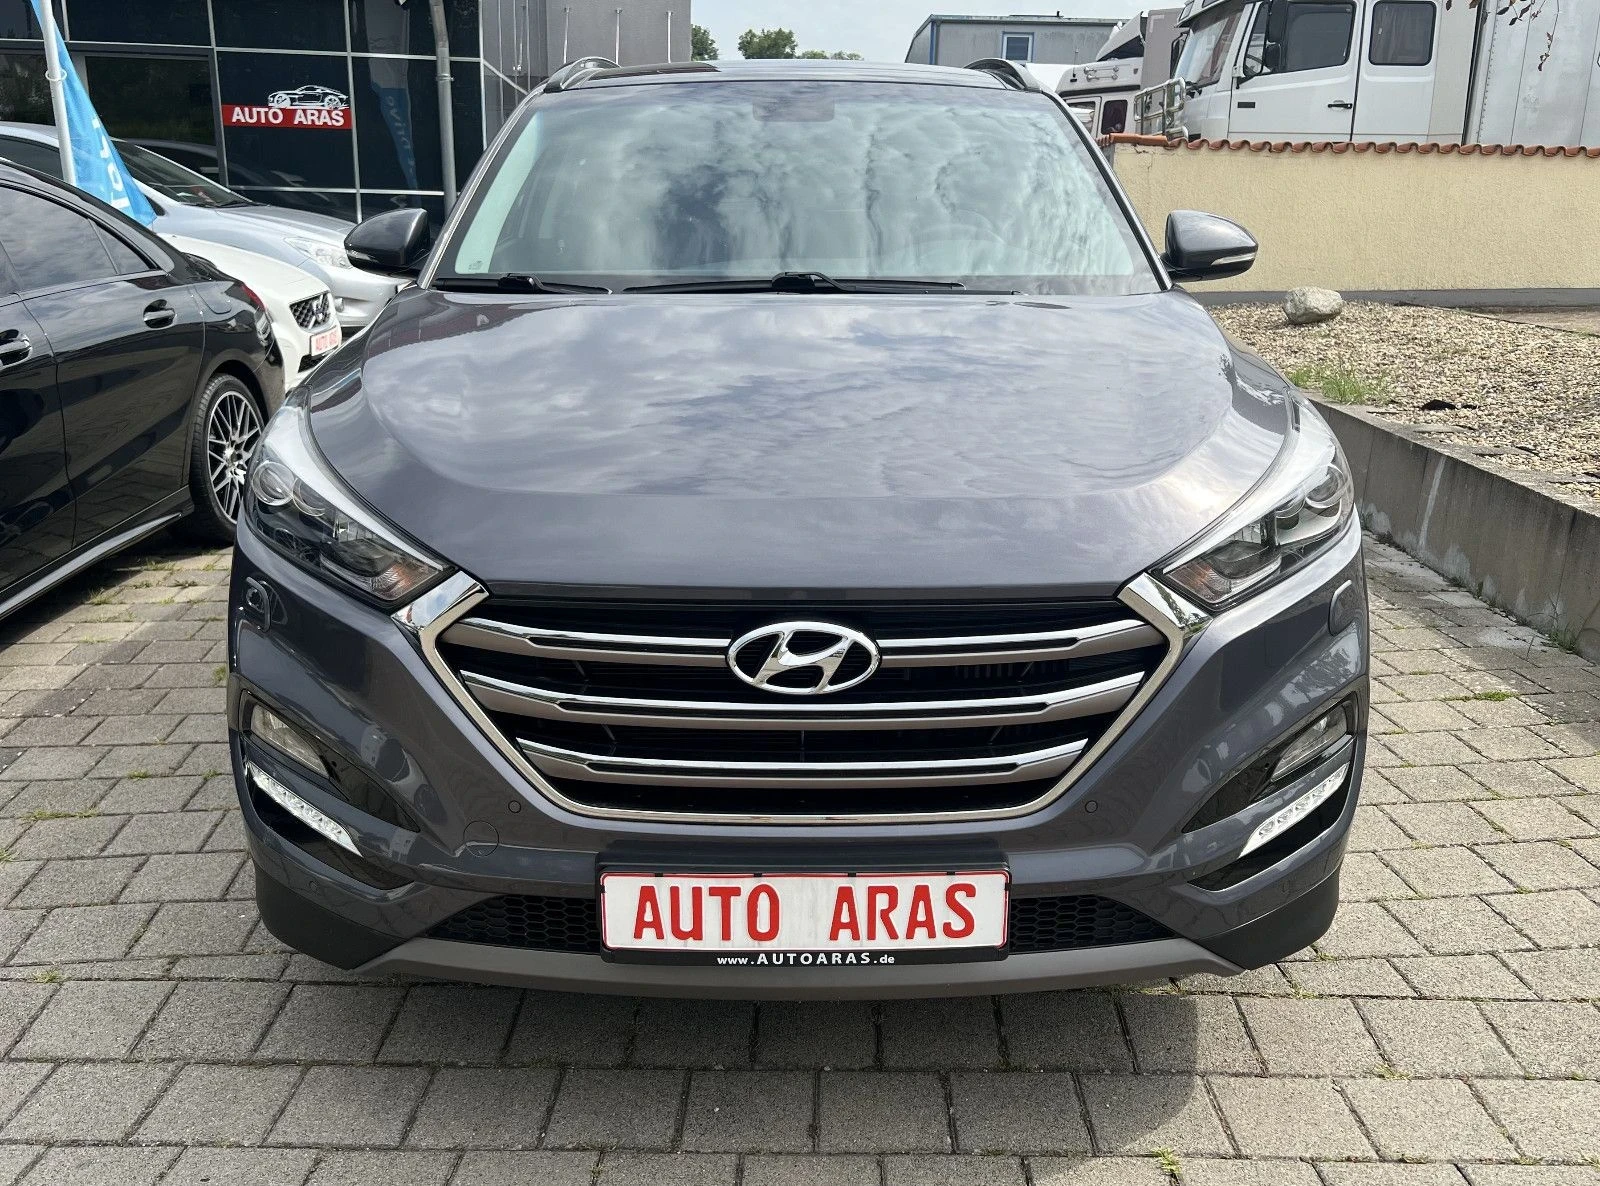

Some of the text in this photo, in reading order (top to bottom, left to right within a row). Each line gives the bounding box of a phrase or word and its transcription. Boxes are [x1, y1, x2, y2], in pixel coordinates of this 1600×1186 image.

[231, 106, 345, 127] AUTO ARAS
[633, 882, 976, 942] AUTO ARAS
[716, 952, 896, 965] www.AUTOARAS.de
